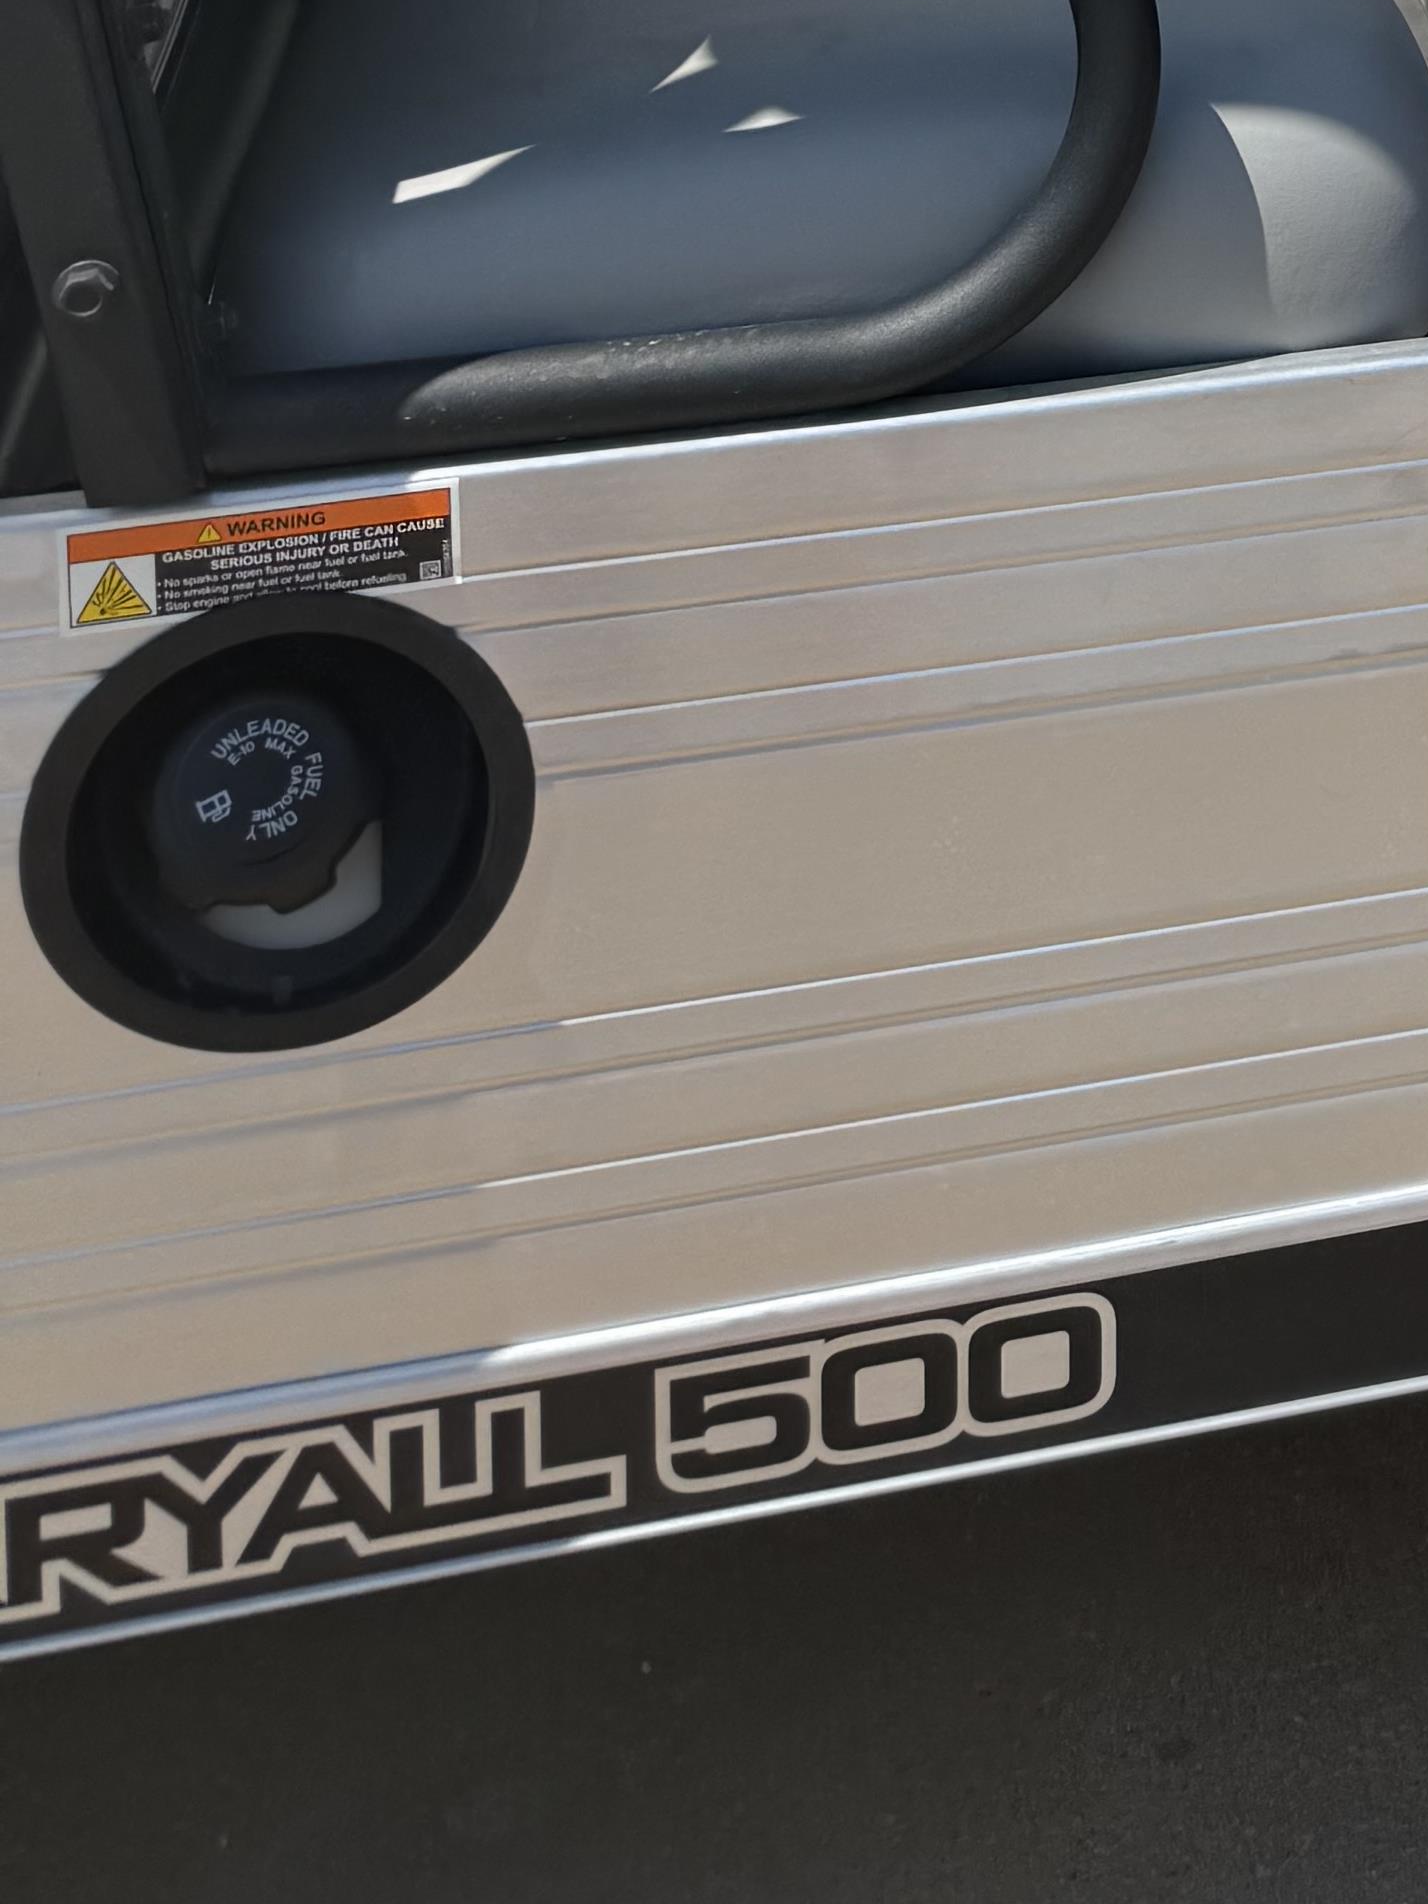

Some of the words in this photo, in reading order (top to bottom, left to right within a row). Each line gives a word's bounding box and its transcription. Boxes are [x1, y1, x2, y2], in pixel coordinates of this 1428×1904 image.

[162, 543, 235, 563] GASOLINE
[239, 533, 318, 553] EXPLOSION
[330, 528, 361, 542] FIRE
[364, 524, 393, 538] CAN
[397, 518, 445, 533] CAUSE
[227, 512, 326, 536] WARNING
[164, 578, 180, 588] No
[183, 573, 218, 587] sparks
[221, 572, 232, 581] or
[236, 568, 263, 581] open
[265, 563, 295, 575] flame
[298, 560, 322, 570] near
[325, 556, 344, 567] fuel
[347, 556, 357, 564] or
[361, 551, 380, 562] fuel
[210, 552, 272, 571] SERIOUS
[276, 547, 326, 563] INJURY
[329, 543, 350, 555] OR
[353, 536, 399, 550] DEATH
[164, 591, 180, 599] No
[184, 584, 229, 597] smoking
[232, 582, 255, 591] near
[259, 577, 278, 588] fuel
[281, 576, 292, 584] or
[295, 572, 315, 583] fuel
[165, 601, 190, 612] Stop
[193, 596, 229, 609] engine
[210, 718, 310, 759] UNLEADED
[227, 741, 255, 766] E-10
[264, 737, 296, 760] MAX
[251, 765, 304, 822] GASOLINE
[299, 752, 323, 800] FUEL
[246, 810, 298, 841] ONLY
[655, 1291, 1118, 1495] 500
